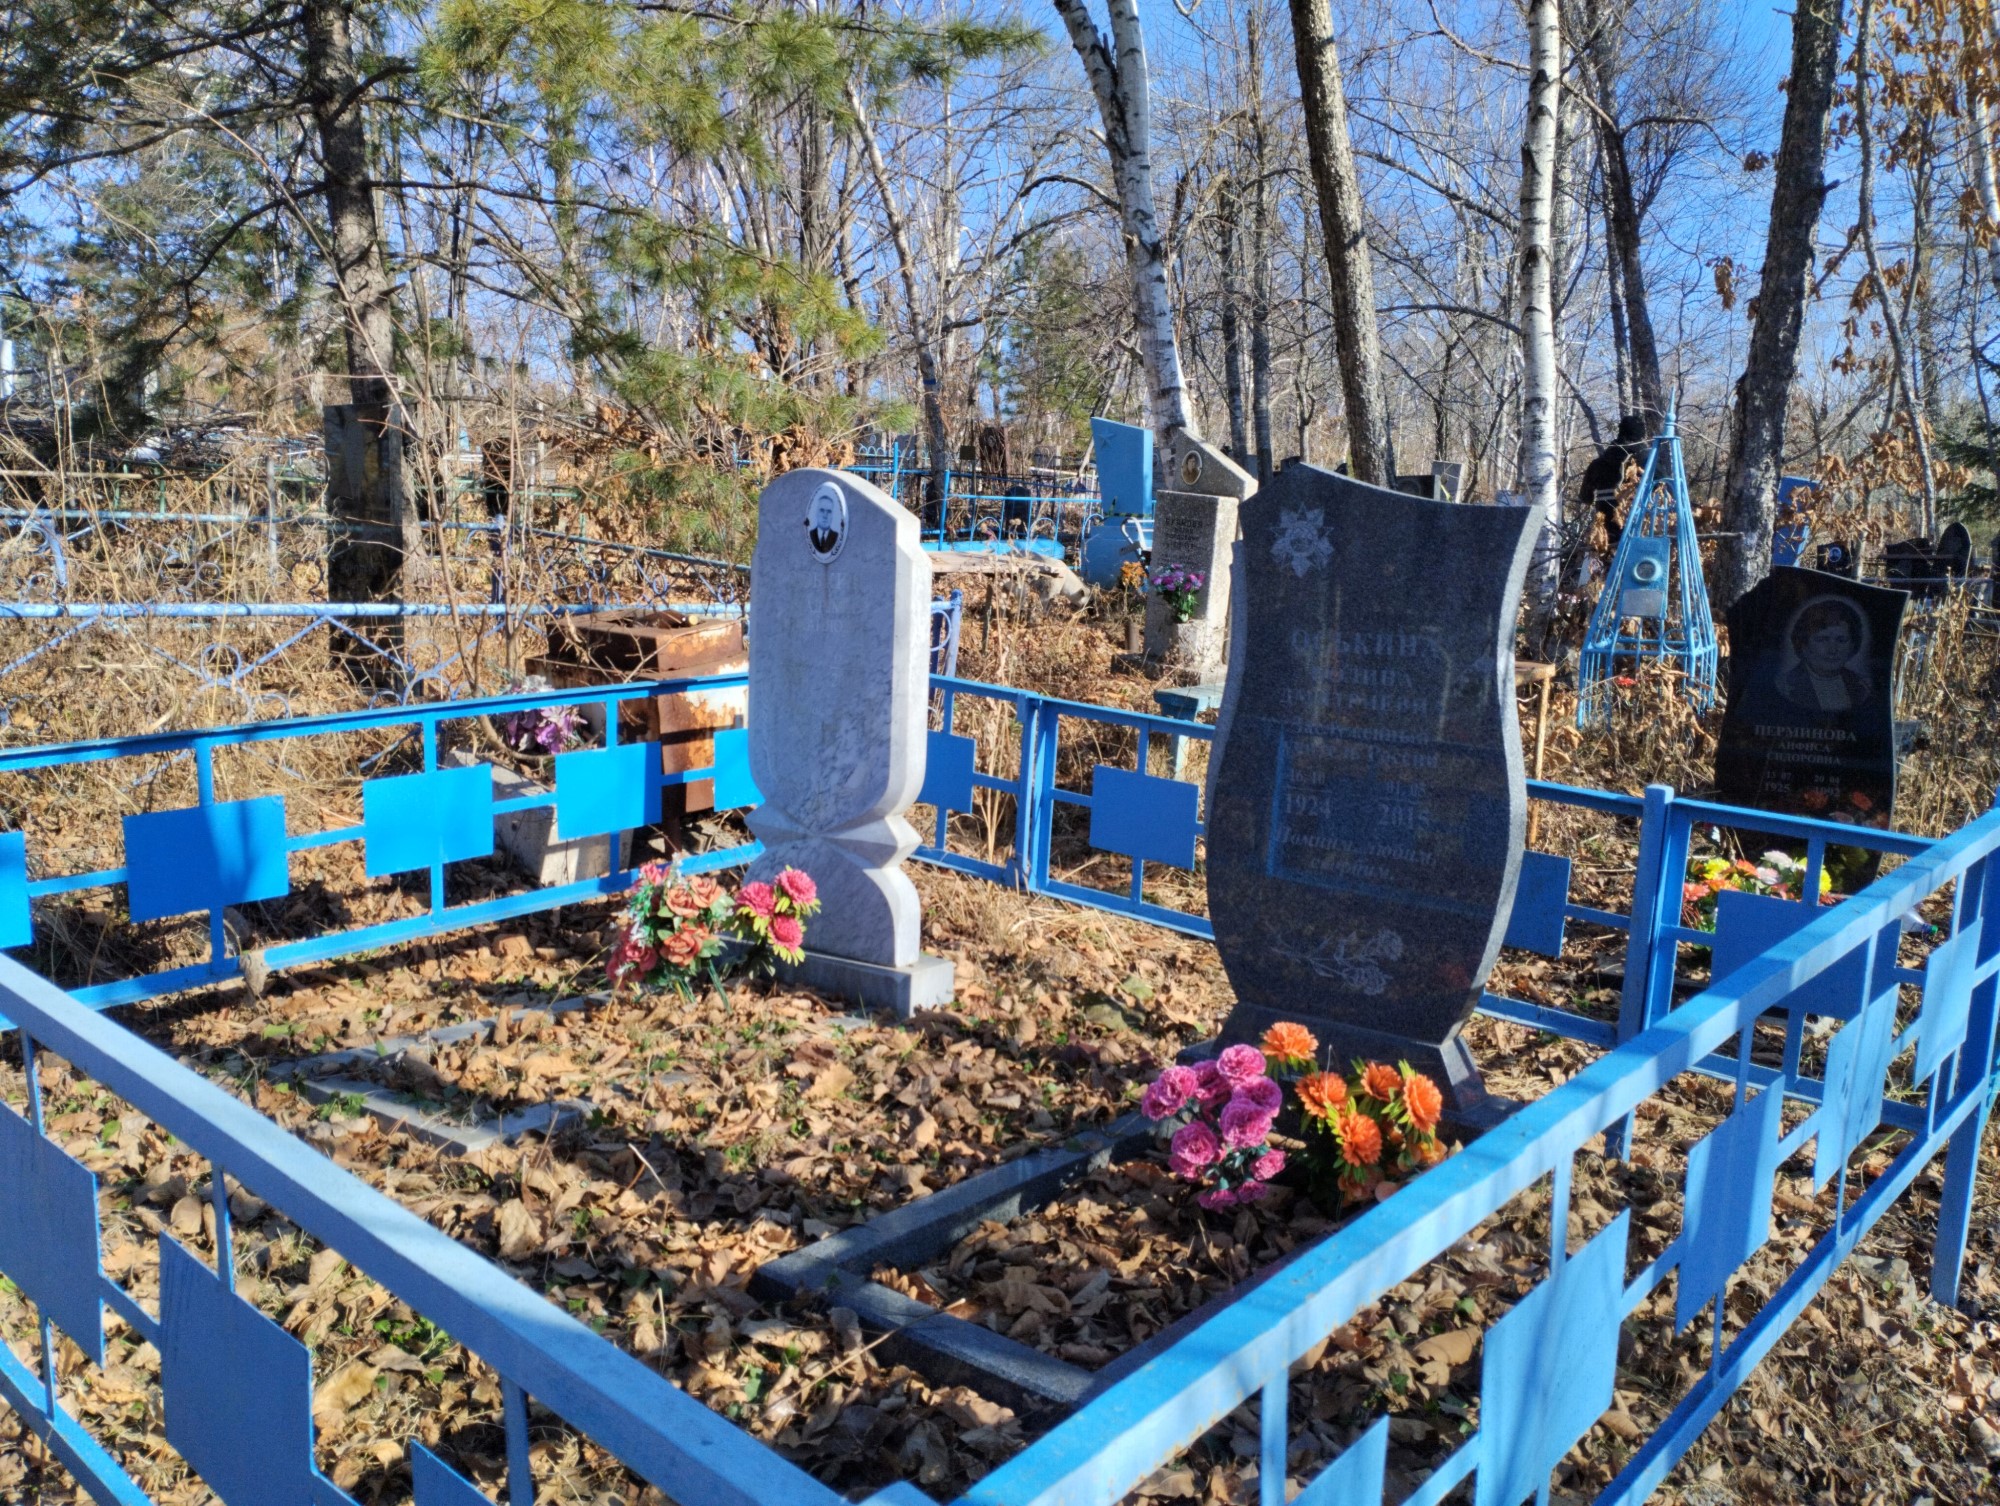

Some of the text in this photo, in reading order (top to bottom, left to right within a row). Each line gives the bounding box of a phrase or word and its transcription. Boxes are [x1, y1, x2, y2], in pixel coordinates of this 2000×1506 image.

[1755, 725, 1857, 741] ПЕРМИНОВА
[1779, 741, 1831, 753] АНФИСА
[1767, 753, 1841, 765] СИДОРОВНА
[1286, 793, 1332, 819] 1924
